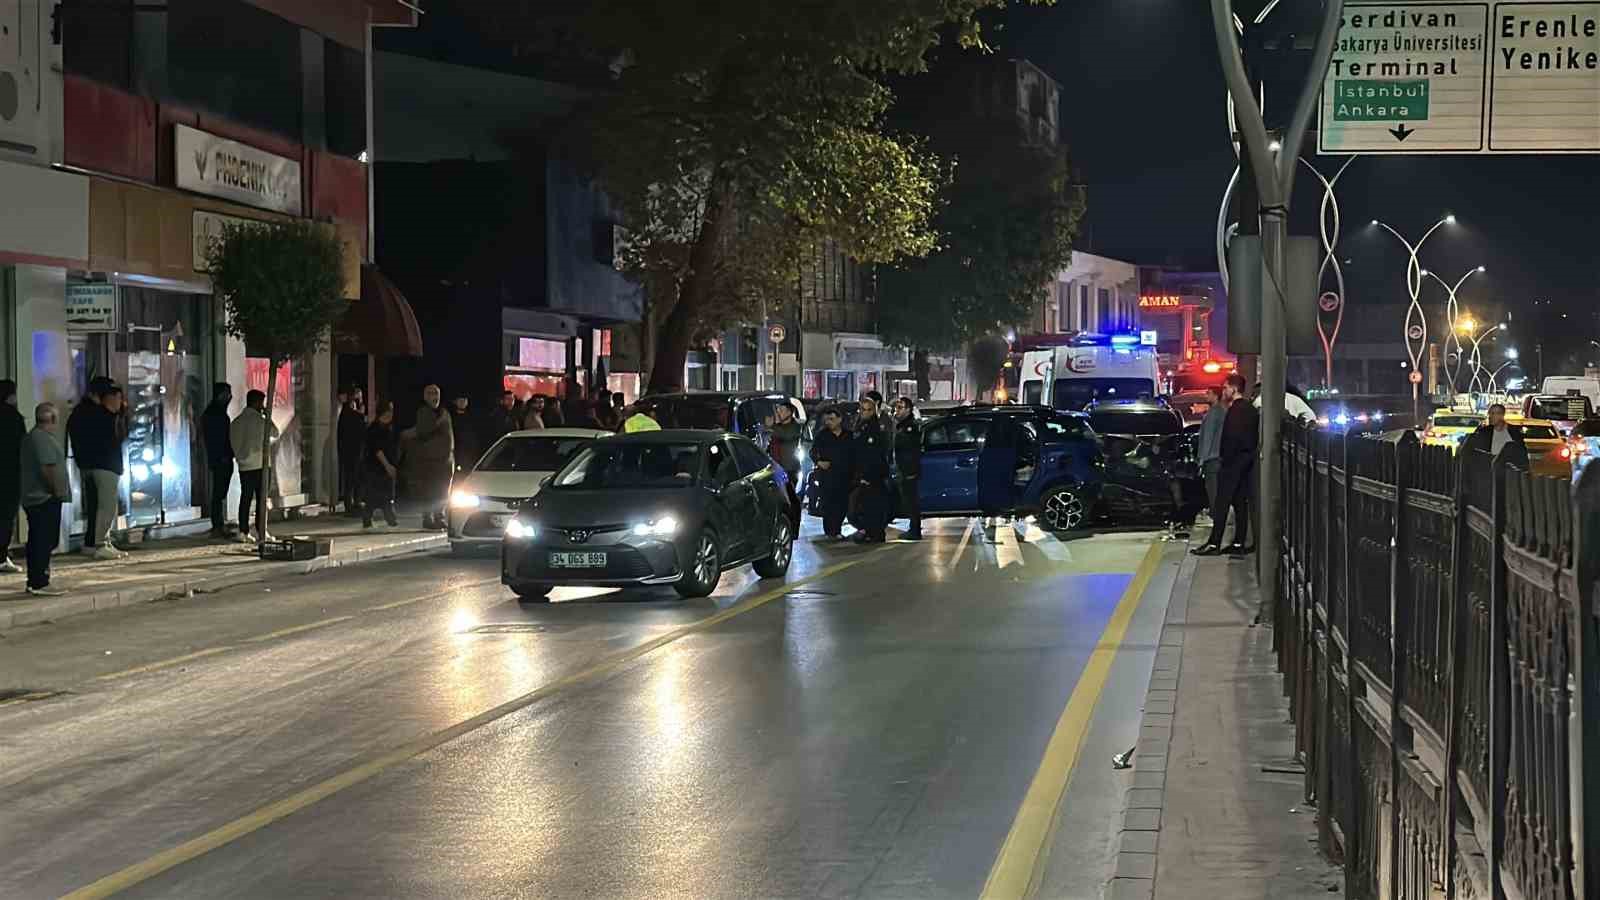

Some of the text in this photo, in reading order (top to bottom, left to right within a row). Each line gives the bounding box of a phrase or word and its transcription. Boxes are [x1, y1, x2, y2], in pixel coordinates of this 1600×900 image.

[1394, 31, 1482, 51] Üniversitesi
[1332, 58, 1457, 76] Terminal
[1339, 81, 1424, 97] İstanbul
[1337, 103, 1409, 117] Ankara
[215, 151, 269, 193] PHOENIX
[550, 553, 566, 565] 34
